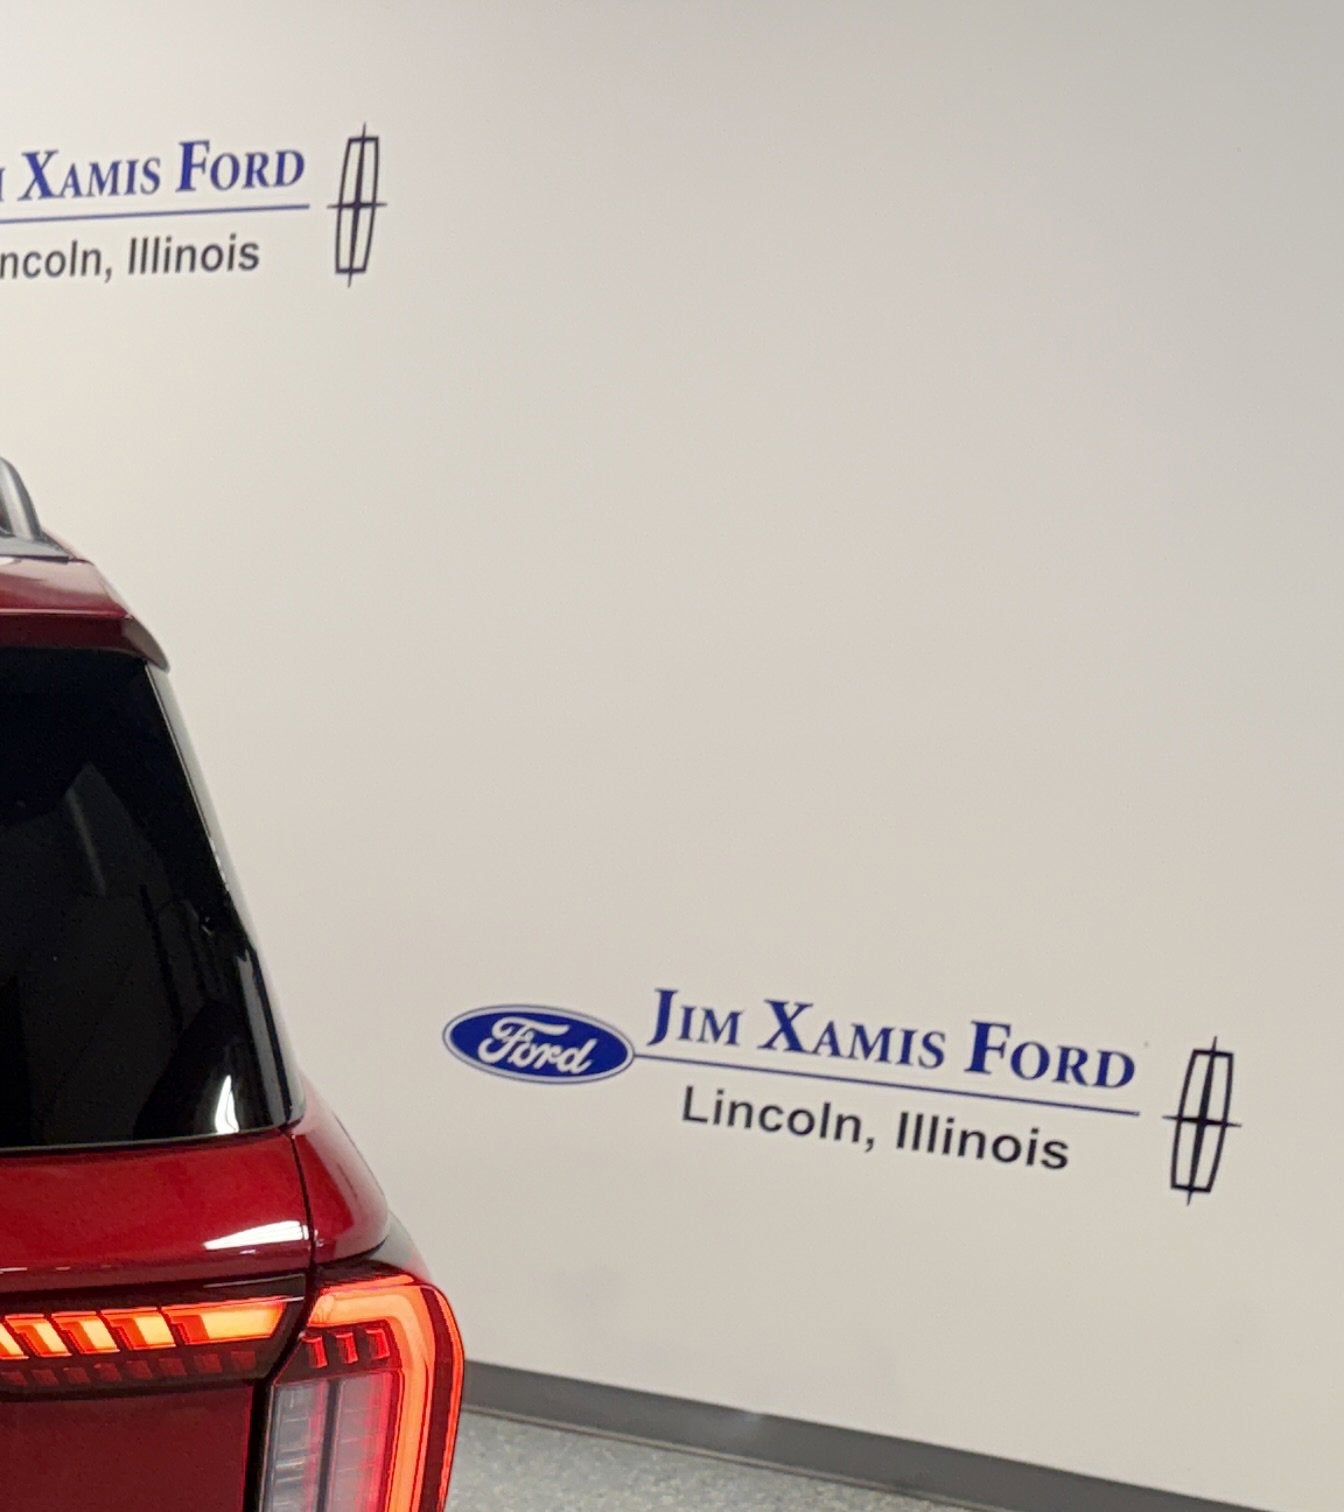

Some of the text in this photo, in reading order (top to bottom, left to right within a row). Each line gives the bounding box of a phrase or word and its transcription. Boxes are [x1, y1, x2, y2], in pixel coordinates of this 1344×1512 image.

[18, 150, 161, 201] XAMIS
[175, 140, 305, 192] FORD
[128, 234, 260, 275] Illinois
[477, 1016, 596, 1076] Ford
[646, 988, 1136, 1089] JIM XAMIS FORD
[682, 1085, 1069, 1170] Lincoln, Illinois
